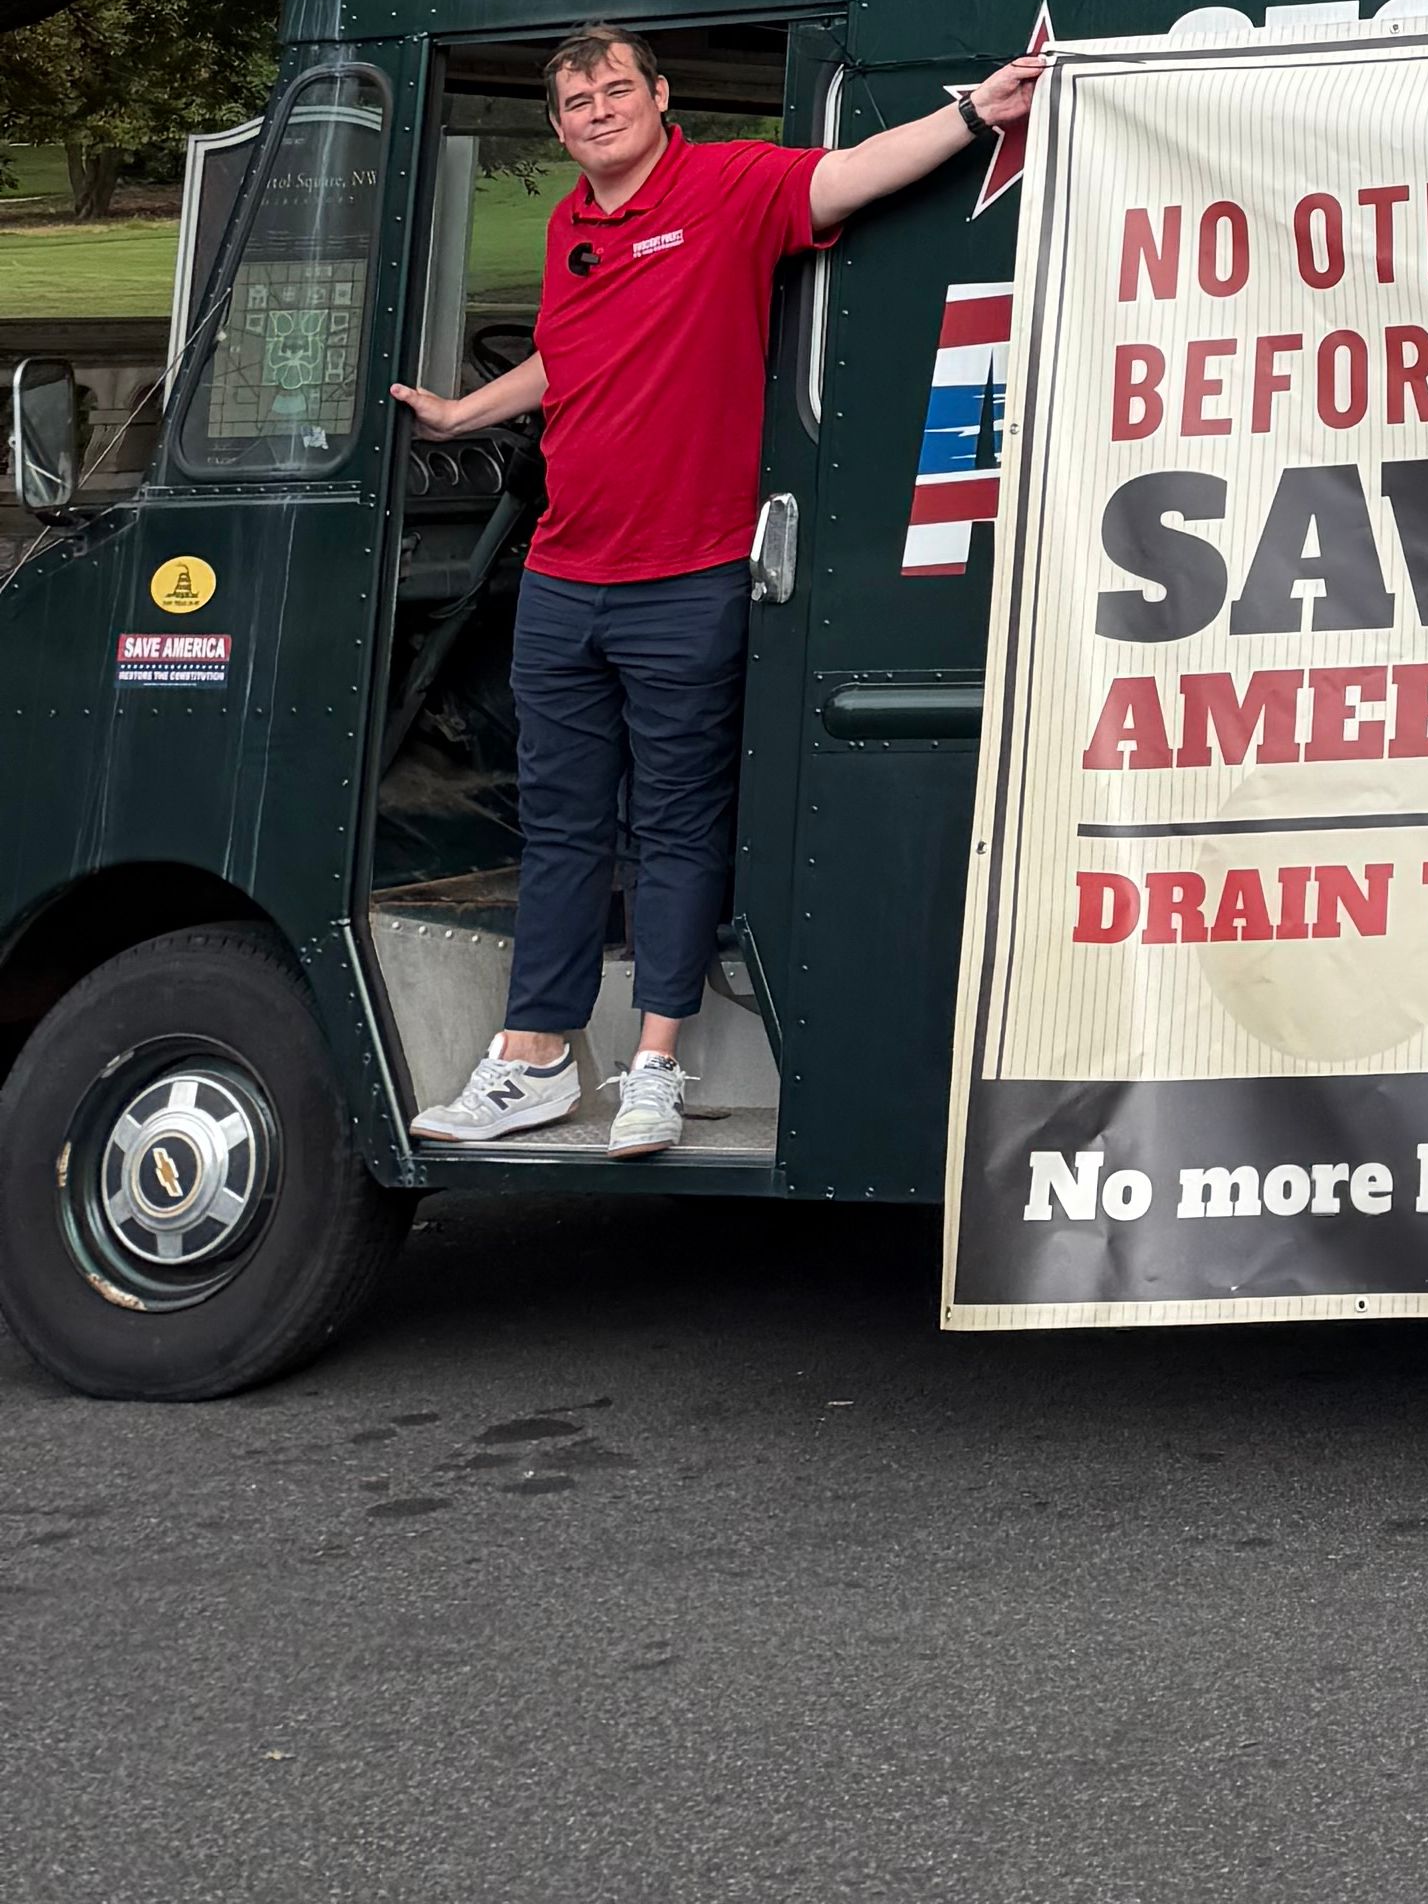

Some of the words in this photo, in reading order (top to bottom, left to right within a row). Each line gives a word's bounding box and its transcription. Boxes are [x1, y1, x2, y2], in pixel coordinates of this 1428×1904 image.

[296, 173, 346, 193] Square,
[1120, 202, 1248, 300] NO
[124, 637, 161, 658] SAVE
[162, 637, 225, 658] AMERICA
[1072, 864, 1392, 944] DRAIN
[1024, 1151, 1152, 1221] No
[1177, 1163, 1393, 1218] more
